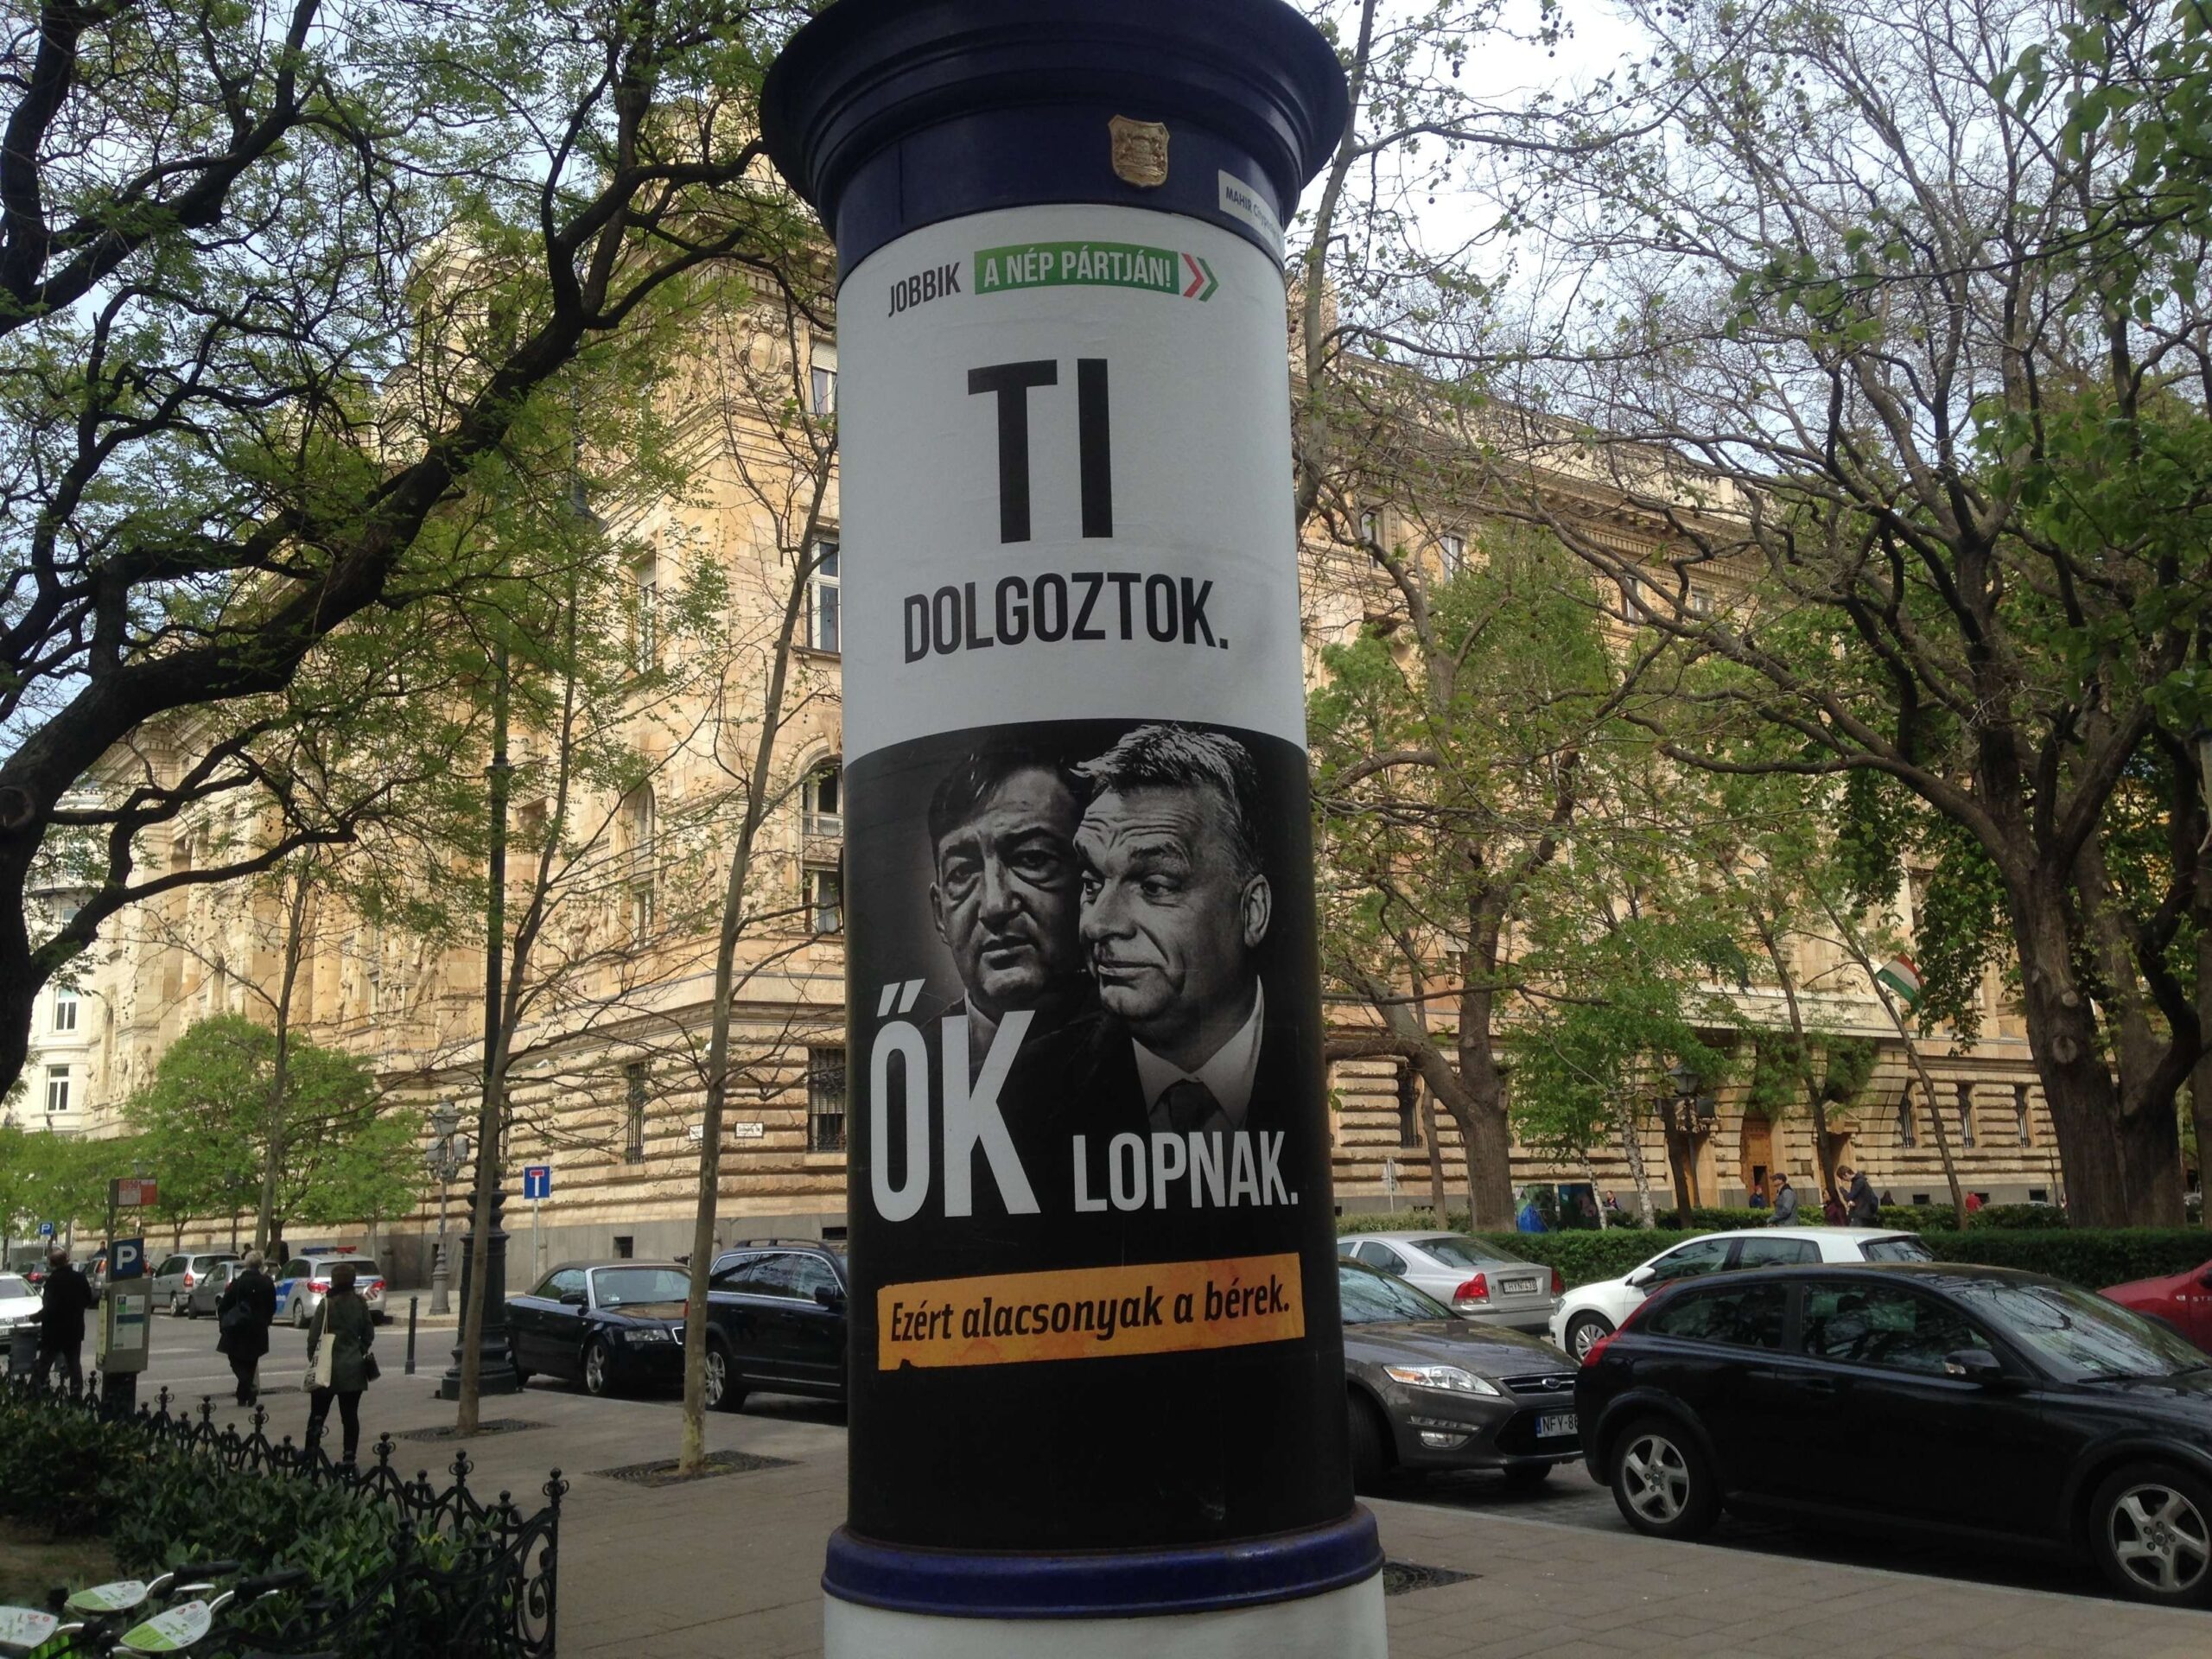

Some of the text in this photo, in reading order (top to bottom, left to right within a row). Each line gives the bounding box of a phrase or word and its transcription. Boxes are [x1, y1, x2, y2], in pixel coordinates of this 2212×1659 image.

[1225, 186, 1252, 213] MAHIR
[887, 262, 962, 318] JOBBIK
[983, 243, 1171, 288] A NÉP PÁRTJÁN!
[967, 358, 1114, 544] TI
[904, 571, 1229, 664] DOLGOZTOK.
[870, 978, 1041, 1222] ŐK
[1072, 1131, 1299, 1212] LOPNAK.
[116, 1245, 137, 1270] P
[891, 1274, 1290, 1342] Ezért alacsonyak a bérek.
